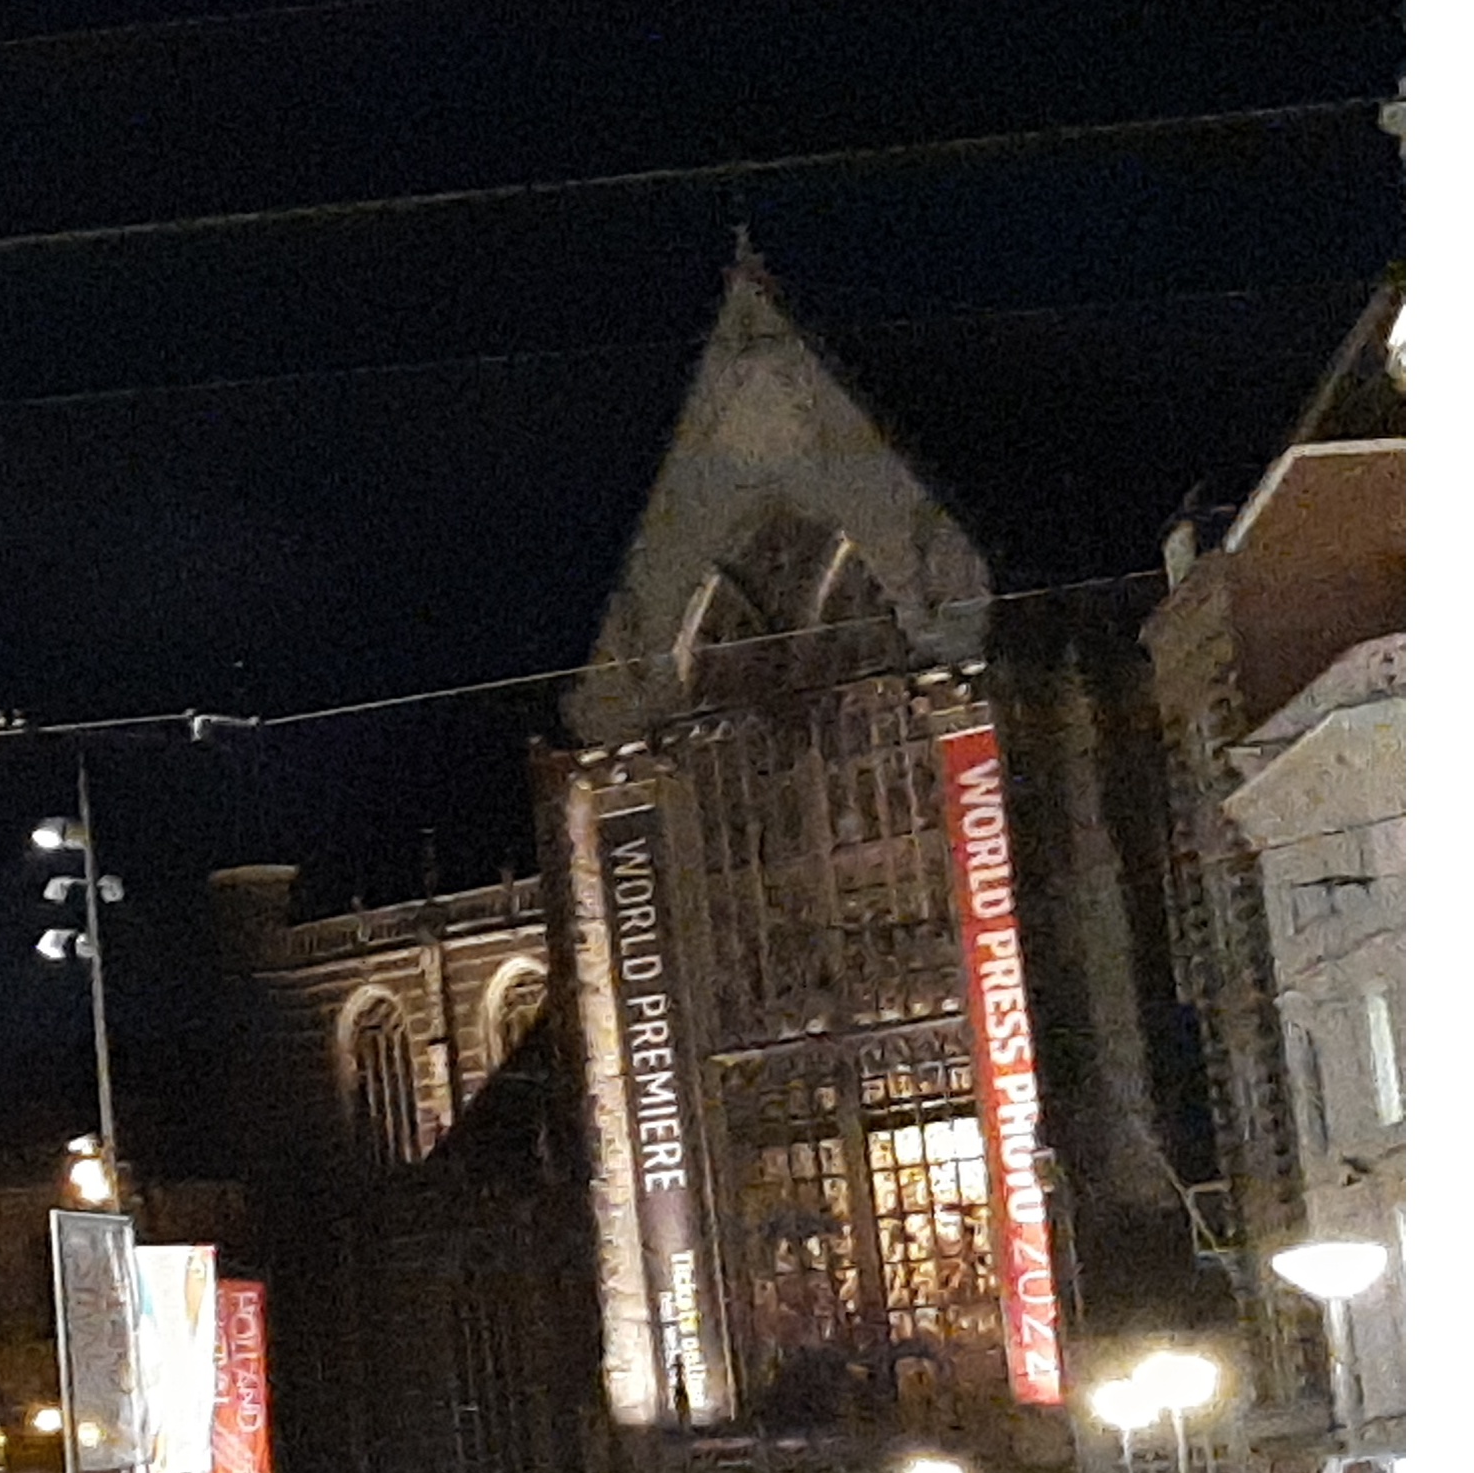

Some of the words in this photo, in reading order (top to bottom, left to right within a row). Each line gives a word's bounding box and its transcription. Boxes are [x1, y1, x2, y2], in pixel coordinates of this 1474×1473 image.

[610, 837, 663, 981] WORLD
[958, 758, 1015, 919] WORLD
[976, 927, 1034, 1066] PRESS
[626, 993, 688, 1194] PREMIERE
[993, 1072, 1047, 1224] PHOTO
[1012, 1238, 1060, 1382] 2022
